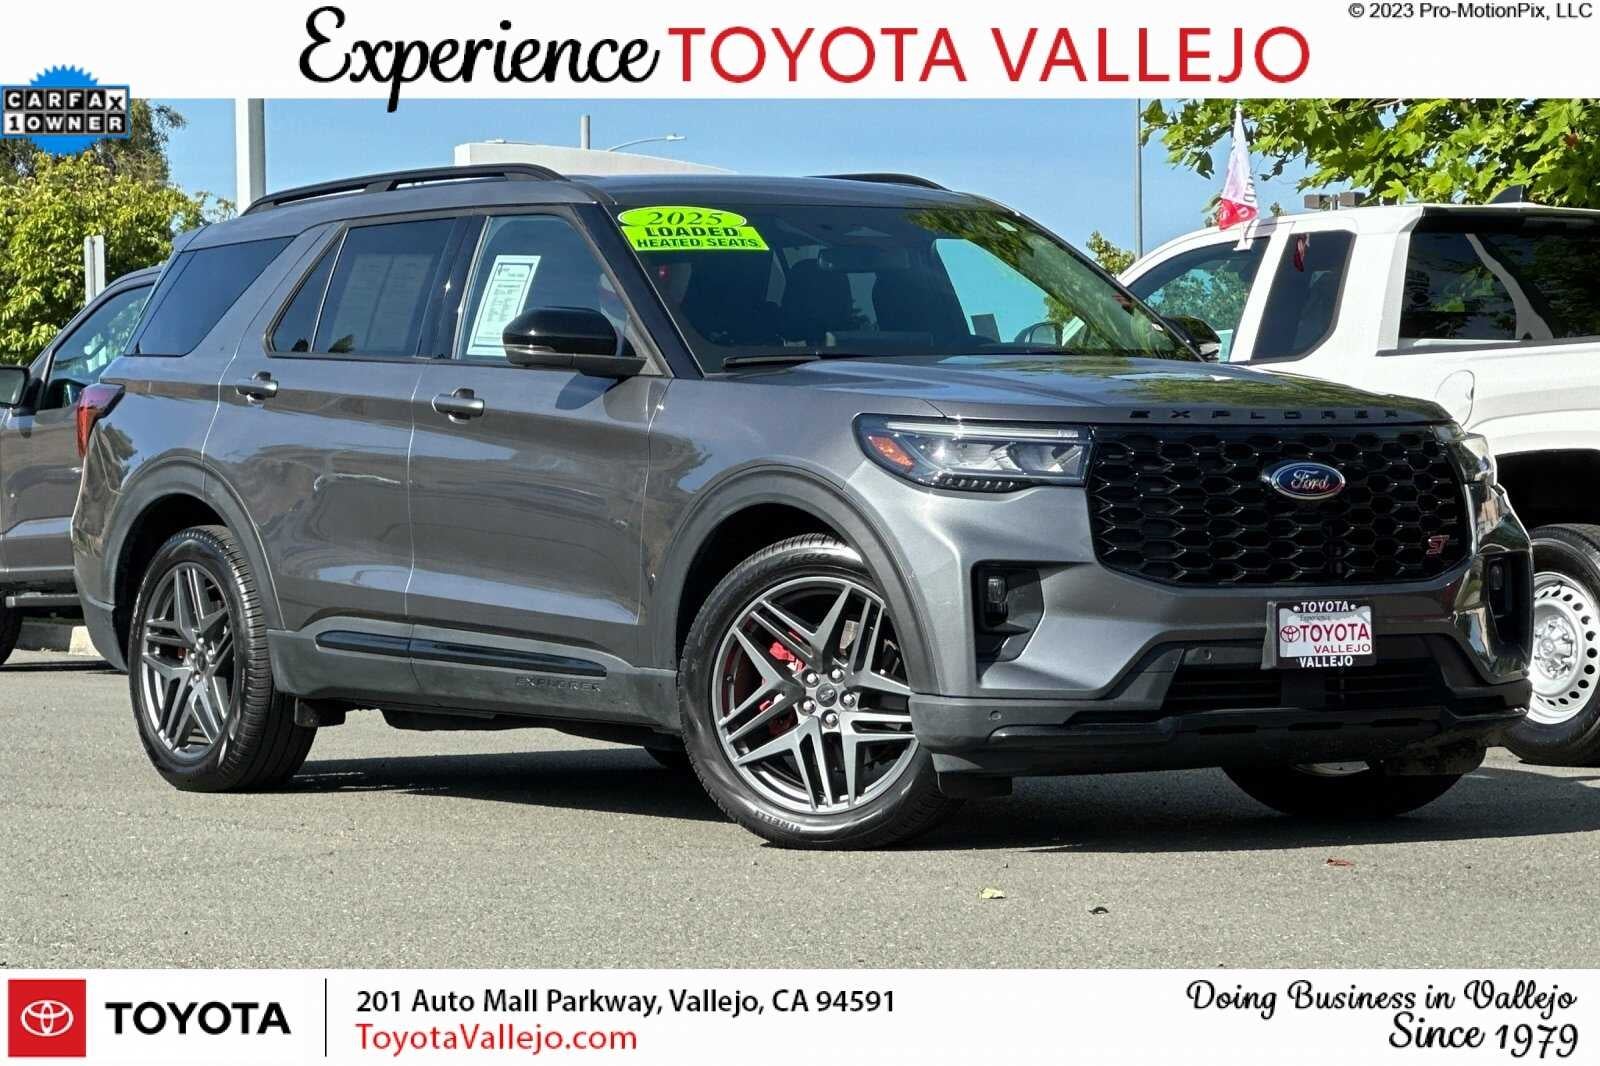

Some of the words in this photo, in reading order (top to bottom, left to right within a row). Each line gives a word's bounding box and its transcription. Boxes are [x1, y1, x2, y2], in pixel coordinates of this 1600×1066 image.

[647, 211, 723, 226] 2025
[644, 226, 739, 237] LOADED
[636, 238, 701, 248] HEATED
[1129, 409, 1399, 420] EXPLORER
[1290, 469, 1330, 490] Ford
[1301, 601, 1349, 613] TOYOTA
[1300, 623, 1370, 642] TOYOTA
[1314, 643, 1371, 654] VALLEJO
[1300, 656, 1353, 668] VALLEJO
